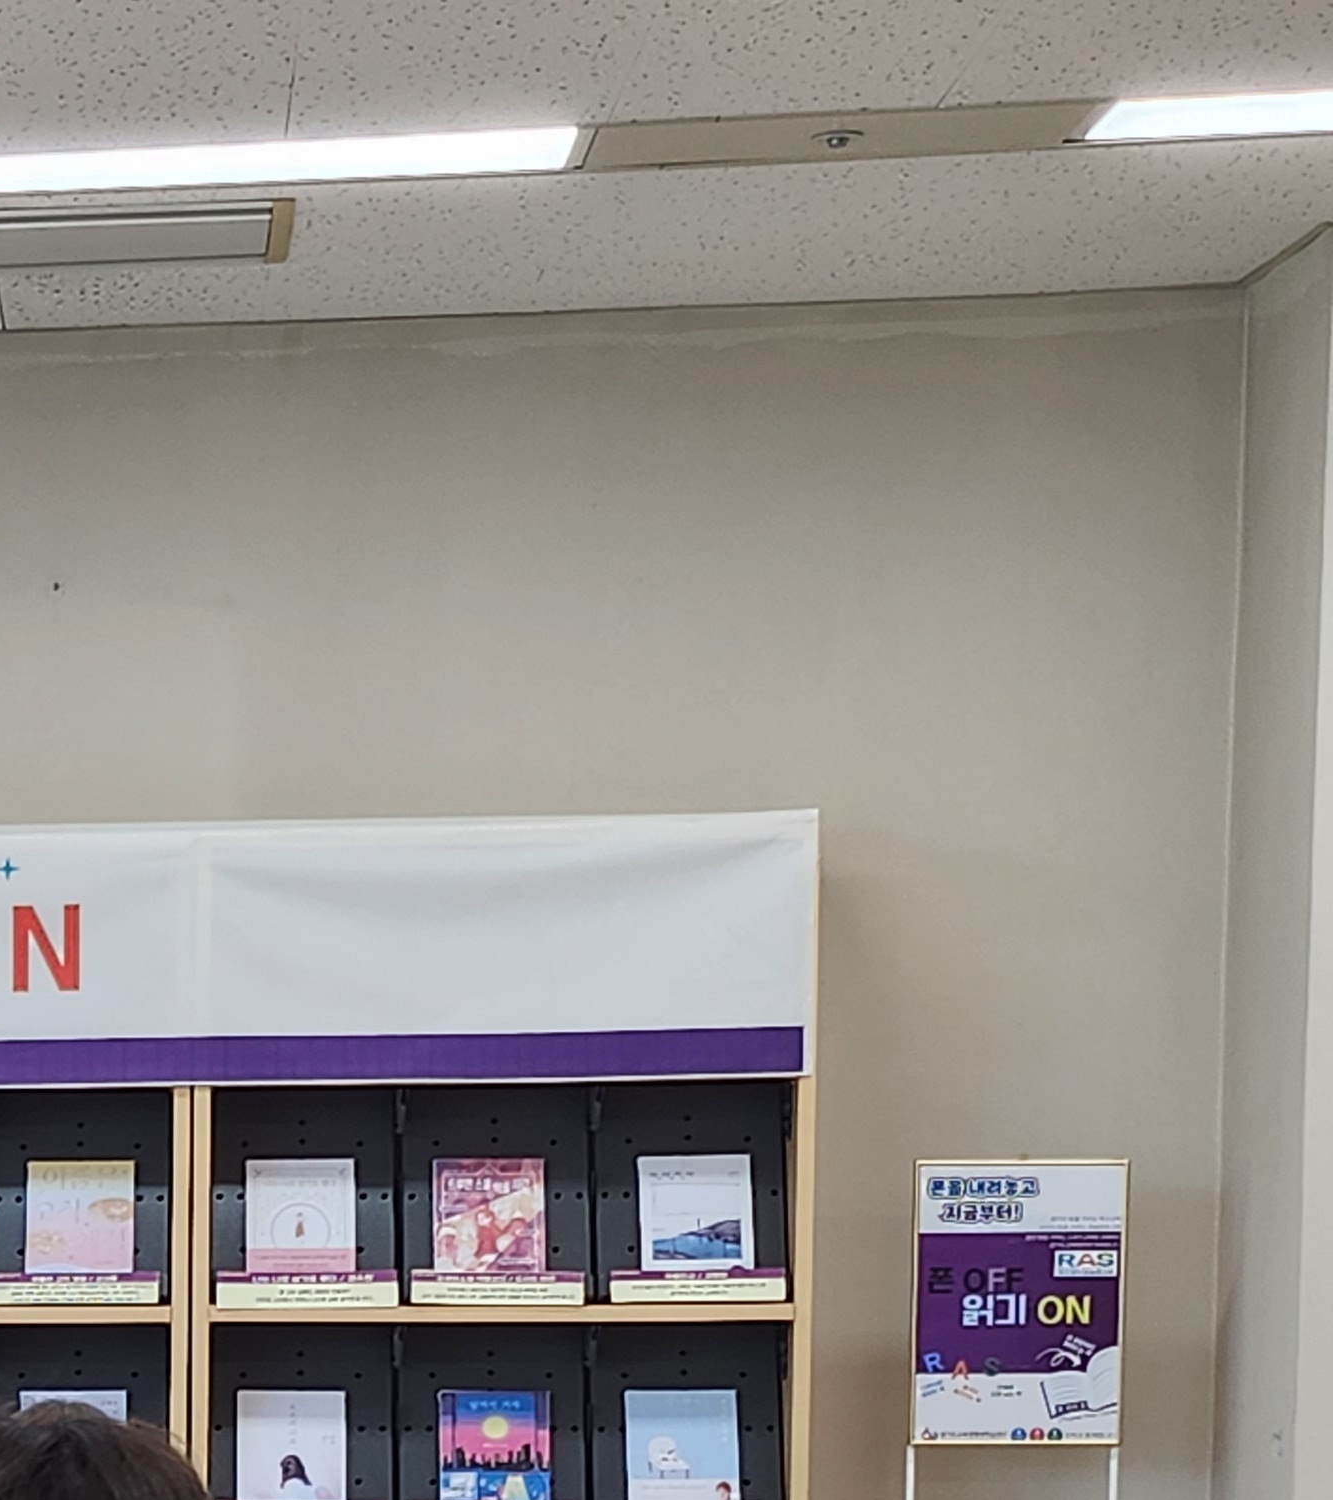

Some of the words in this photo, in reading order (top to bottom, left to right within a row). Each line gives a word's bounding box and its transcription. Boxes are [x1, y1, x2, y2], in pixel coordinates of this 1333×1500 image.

[967, 1178, 1038, 1197] 내려놓고
[941, 1203, 1021, 1222] 지금부터!
[1057, 1252, 1116, 1268] RAS
[927, 1266, 955, 1295] 폰
[963, 1266, 1025, 1294] OFF
[960, 1293, 1028, 1328] 읽기
[1036, 1293, 1093, 1326] ON
